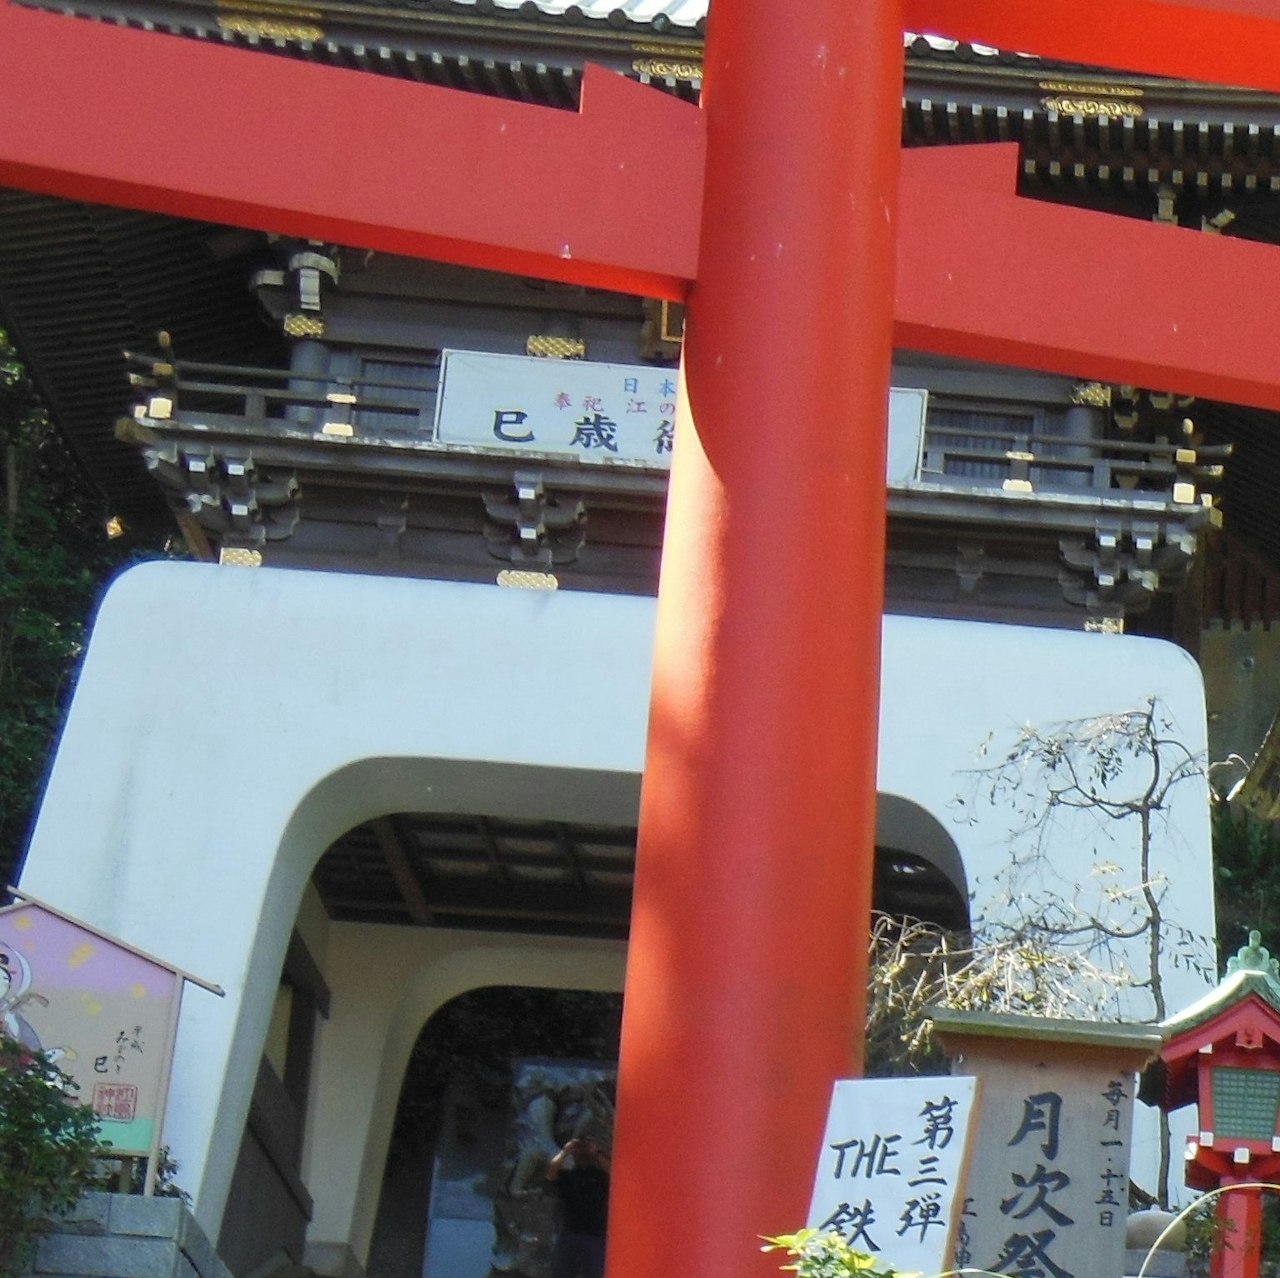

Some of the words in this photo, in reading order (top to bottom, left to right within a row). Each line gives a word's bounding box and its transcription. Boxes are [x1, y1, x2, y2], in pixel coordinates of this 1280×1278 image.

[829, 1134, 902, 1179] THE
[895, 1095, 958, 1244] 第三弾
